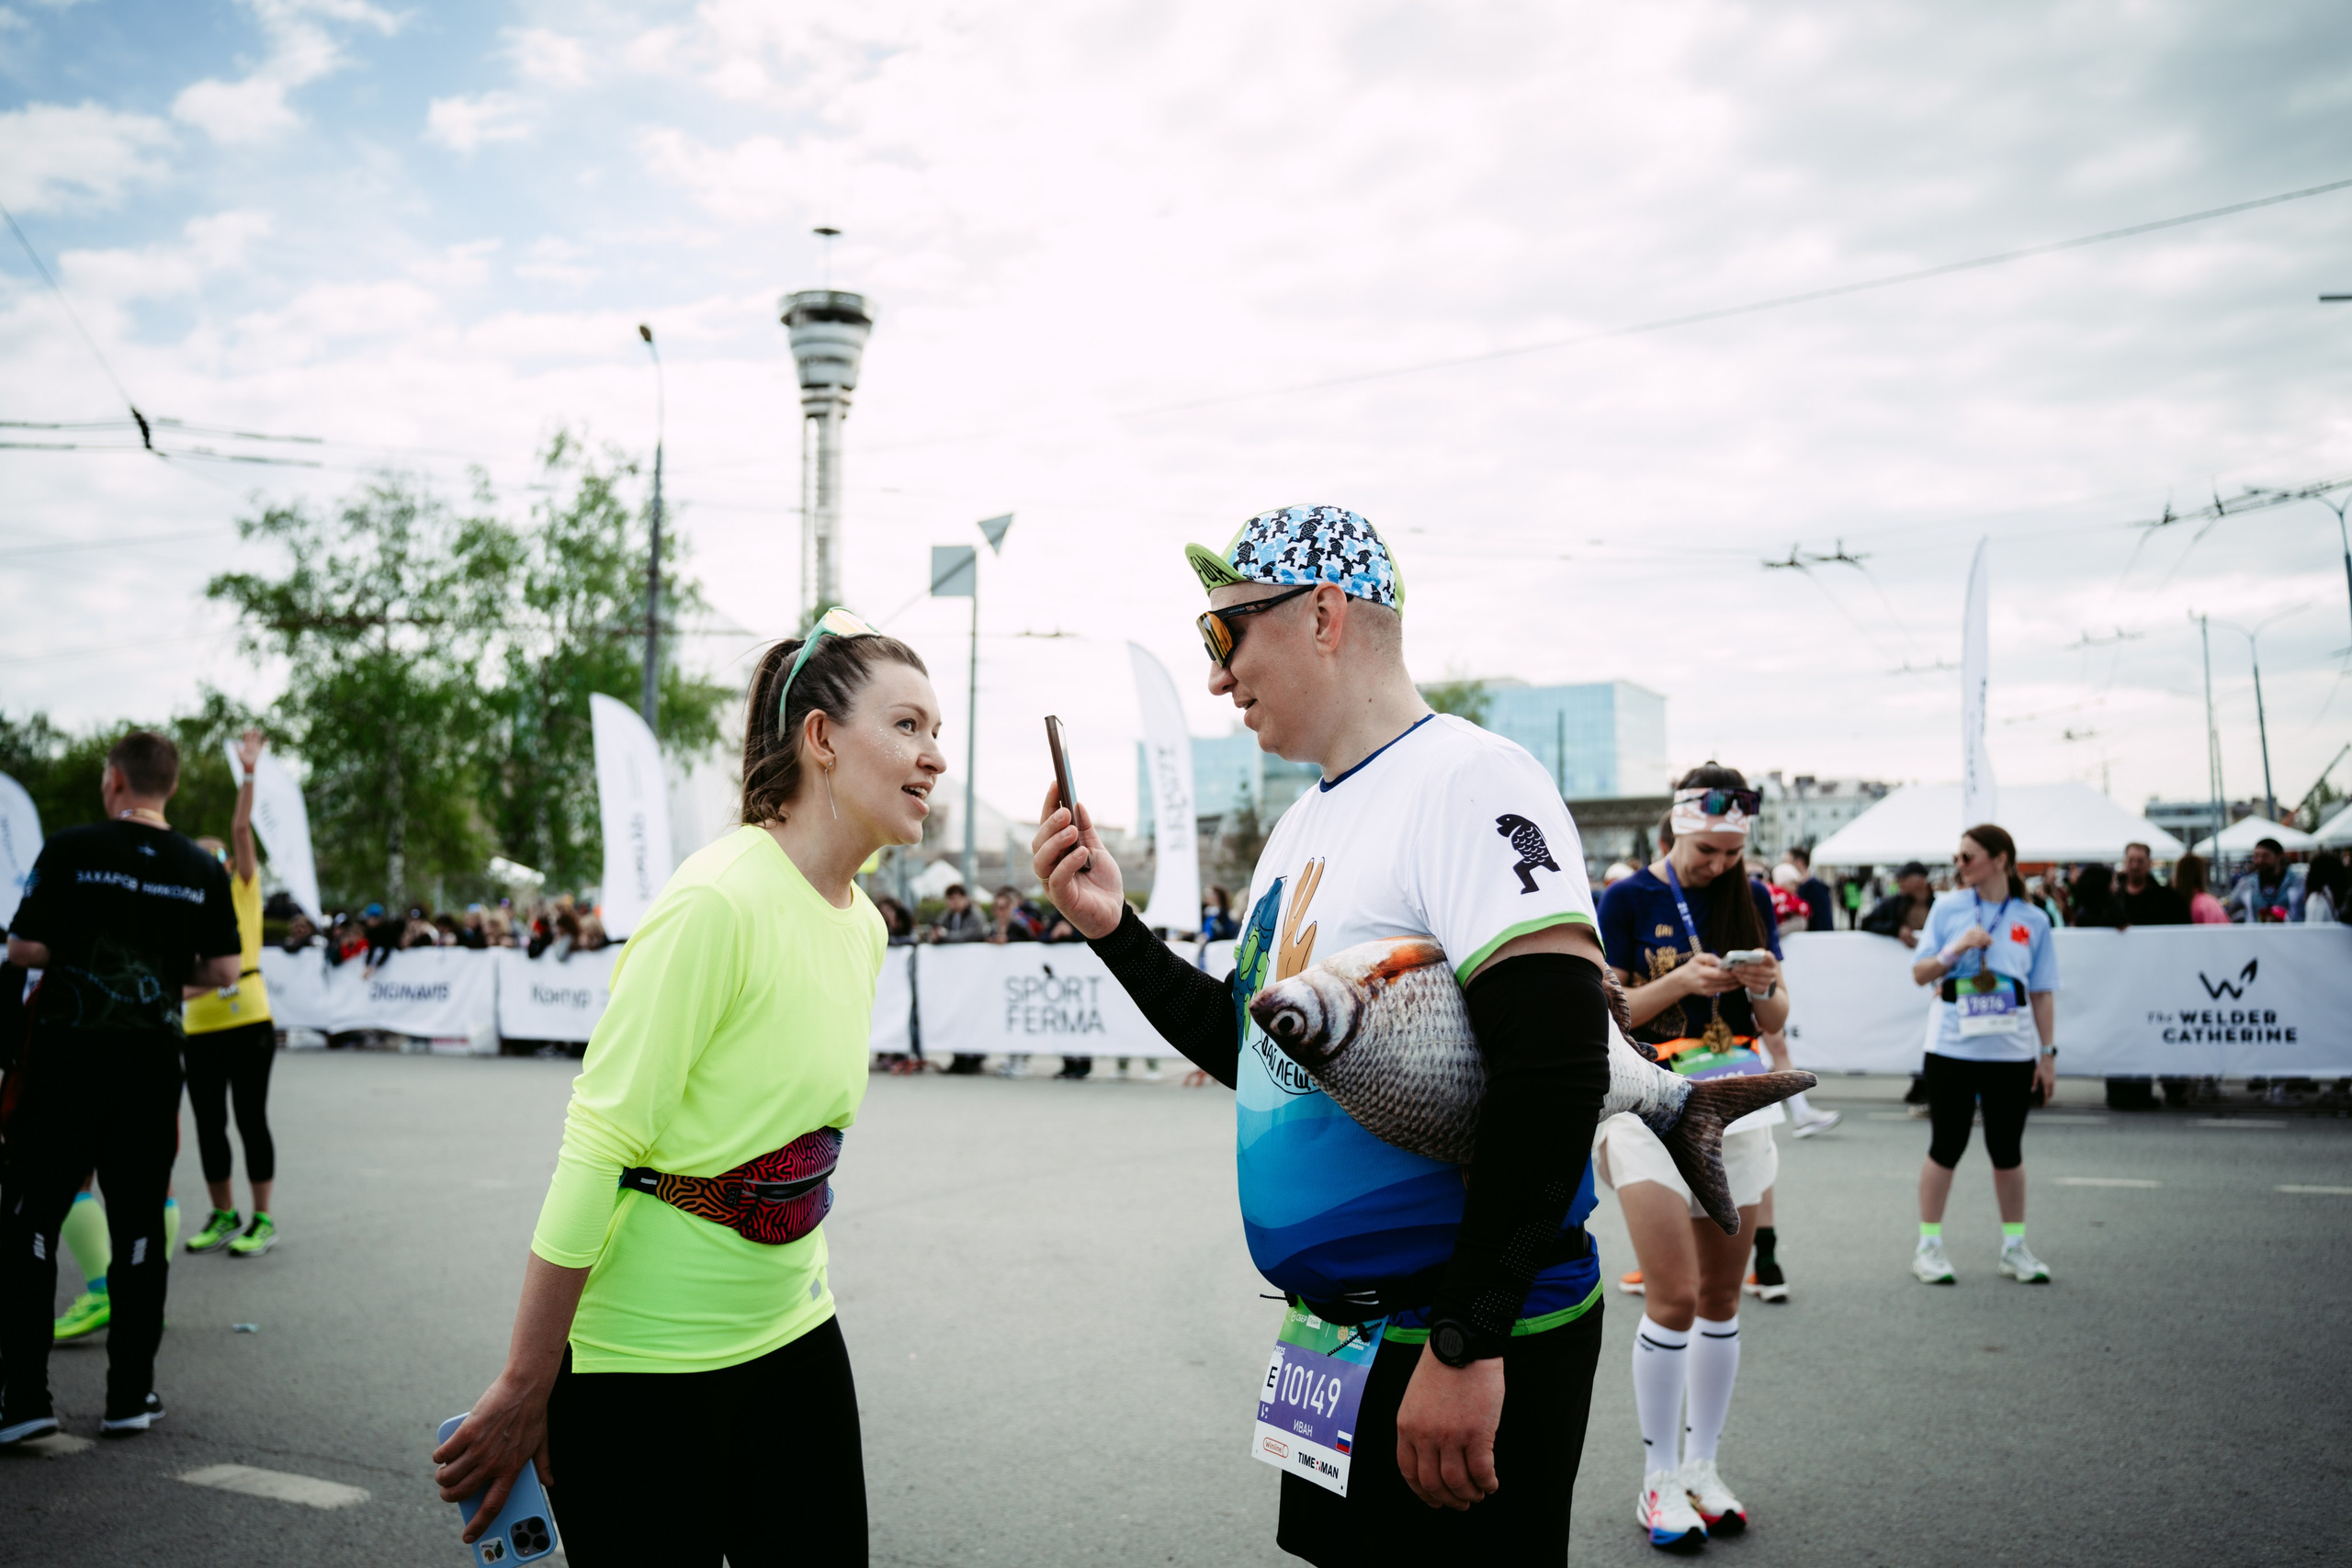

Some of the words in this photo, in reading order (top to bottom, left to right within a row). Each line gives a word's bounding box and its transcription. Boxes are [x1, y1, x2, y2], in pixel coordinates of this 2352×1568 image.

[1005, 976, 1102, 1003] SPORT
[1006, 1005, 1105, 1035] FERMA
[2178, 1010, 2278, 1026] WELDER
[2162, 1026, 2299, 1044] CATHERINE
[1276, 1057, 1317, 1091] ЛЕЩ
[1281, 1362, 1341, 1418] 10149
[1293, 1418, 1313, 1438] ИВАН
[1265, 1440, 1283, 1453] Winline
